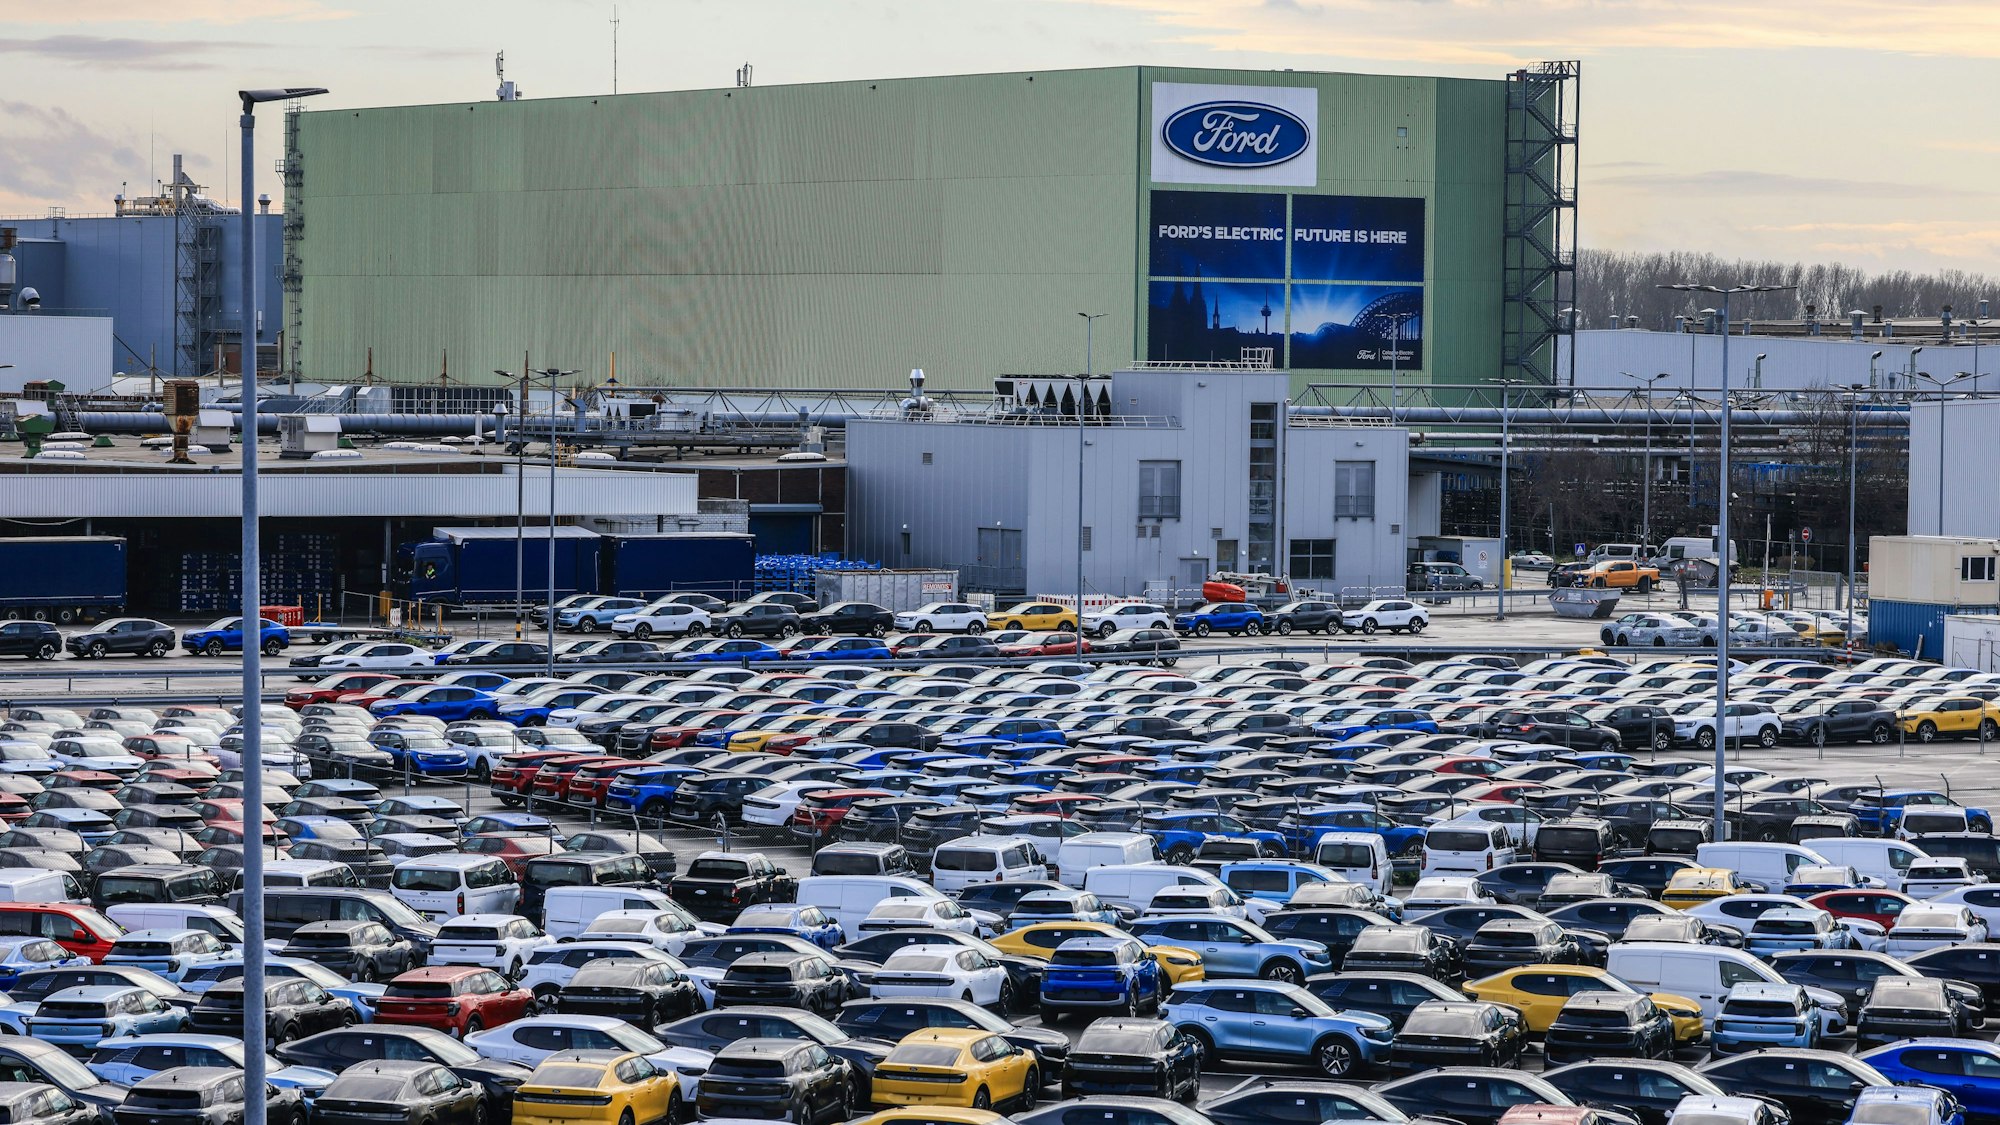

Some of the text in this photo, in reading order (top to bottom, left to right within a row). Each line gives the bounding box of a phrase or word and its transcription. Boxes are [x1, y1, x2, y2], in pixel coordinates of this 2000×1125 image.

[1193, 110, 1281, 155] Ford
[1159, 225, 1407, 244] FORD'S ELECTRIC FUTURE IS HERE
[1357, 349, 1376, 360] Ford
